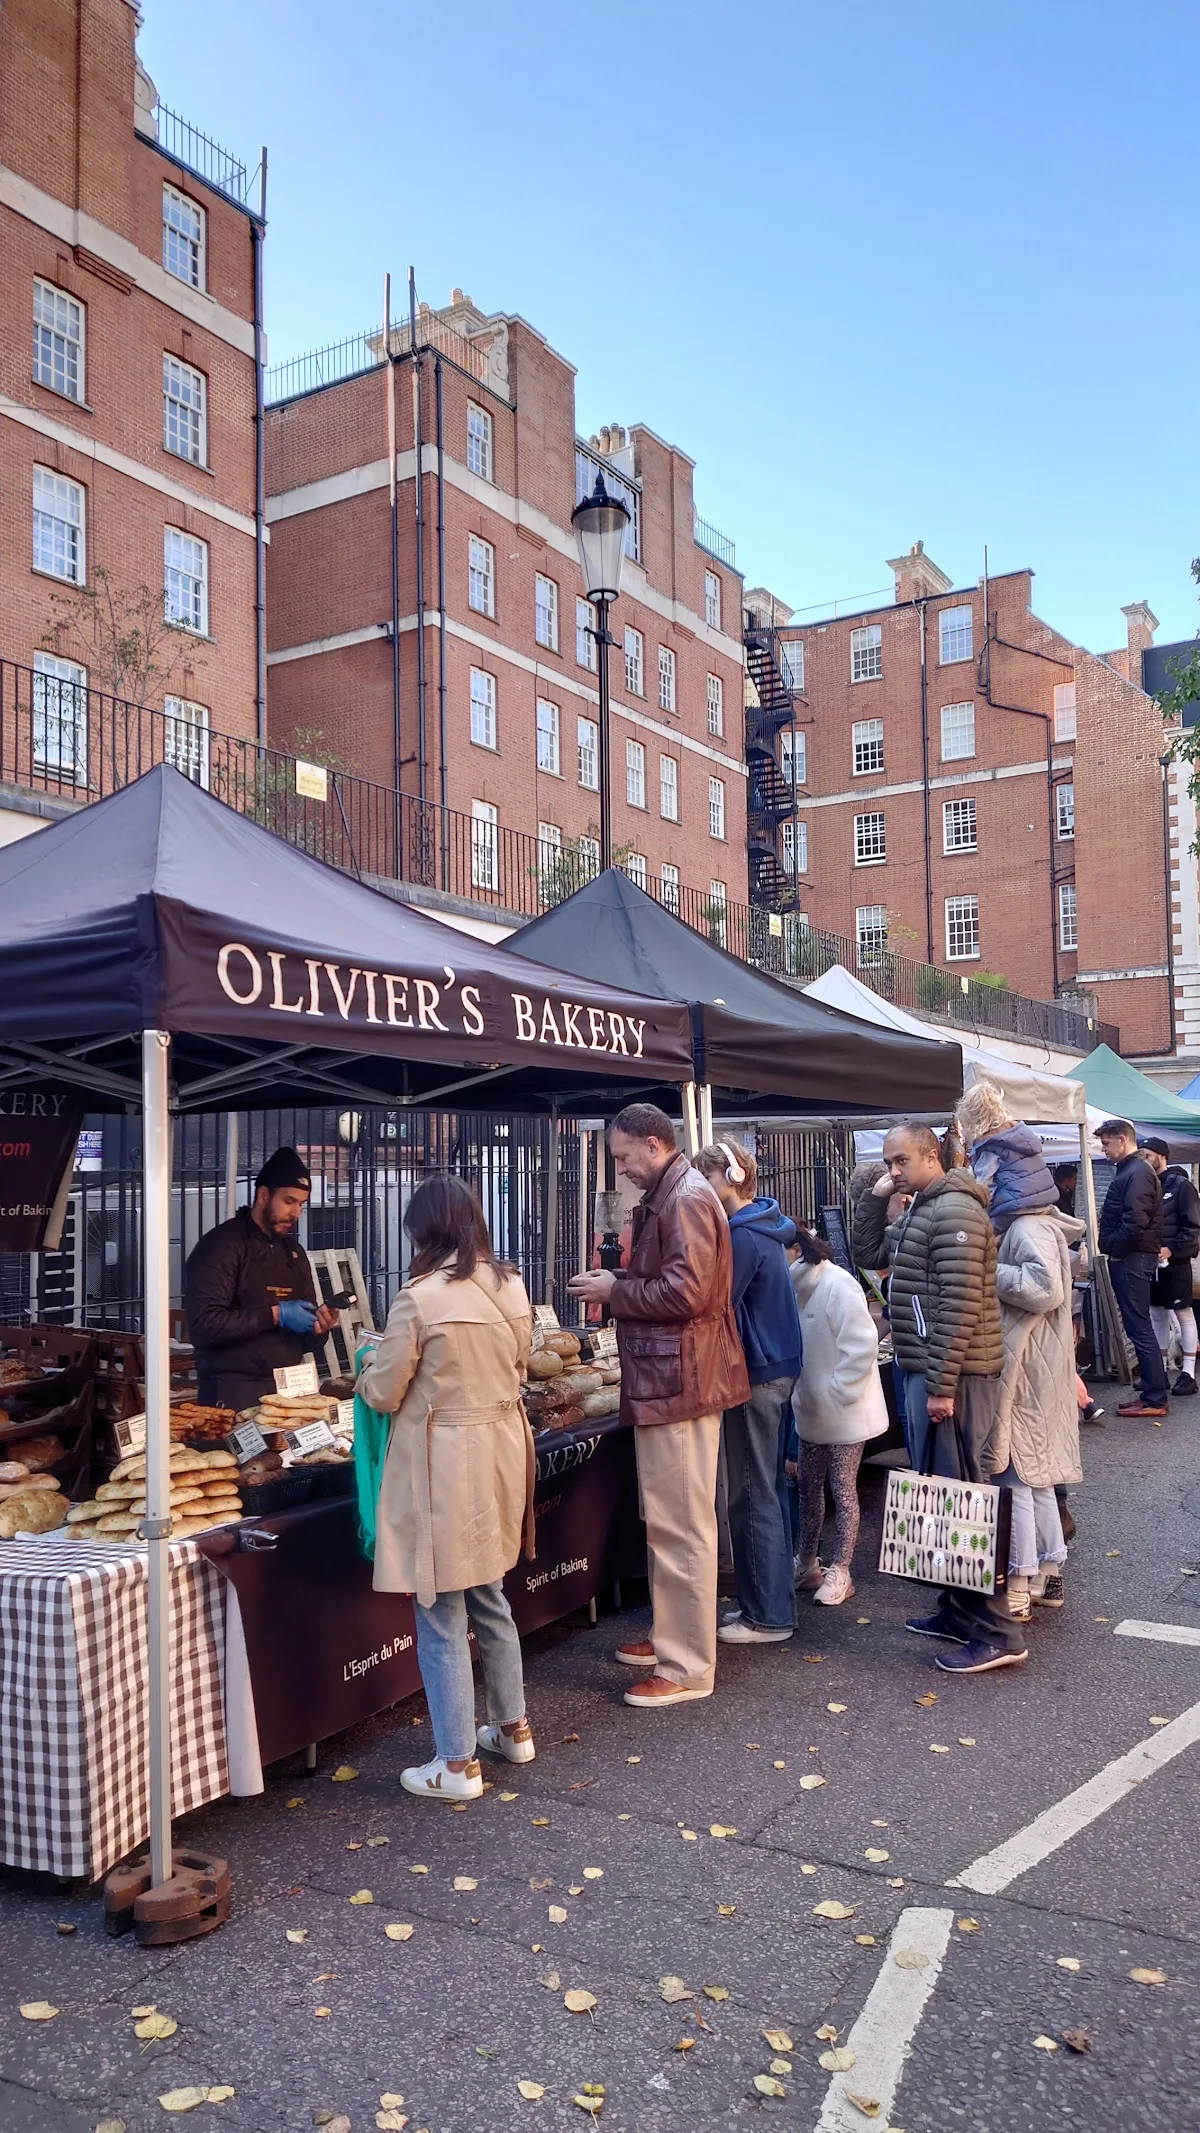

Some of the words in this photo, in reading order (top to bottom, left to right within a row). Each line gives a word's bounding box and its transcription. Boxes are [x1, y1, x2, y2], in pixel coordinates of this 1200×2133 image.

[216, 942, 485, 1036] OLIVIER'S
[510, 993, 646, 1059] BAKERY
[8, 1204, 21, 1216] of
[23, 1204, 53, 1217] Bakin
[526, 1571, 549, 1593] Spirit
[550, 1564, 560, 1580] of
[561, 1557, 589, 1577] Baking
[343, 1651, 380, 1682] L'Esprit
[381, 1643, 393, 1661] du
[394, 1634, 413, 1654] Pain
